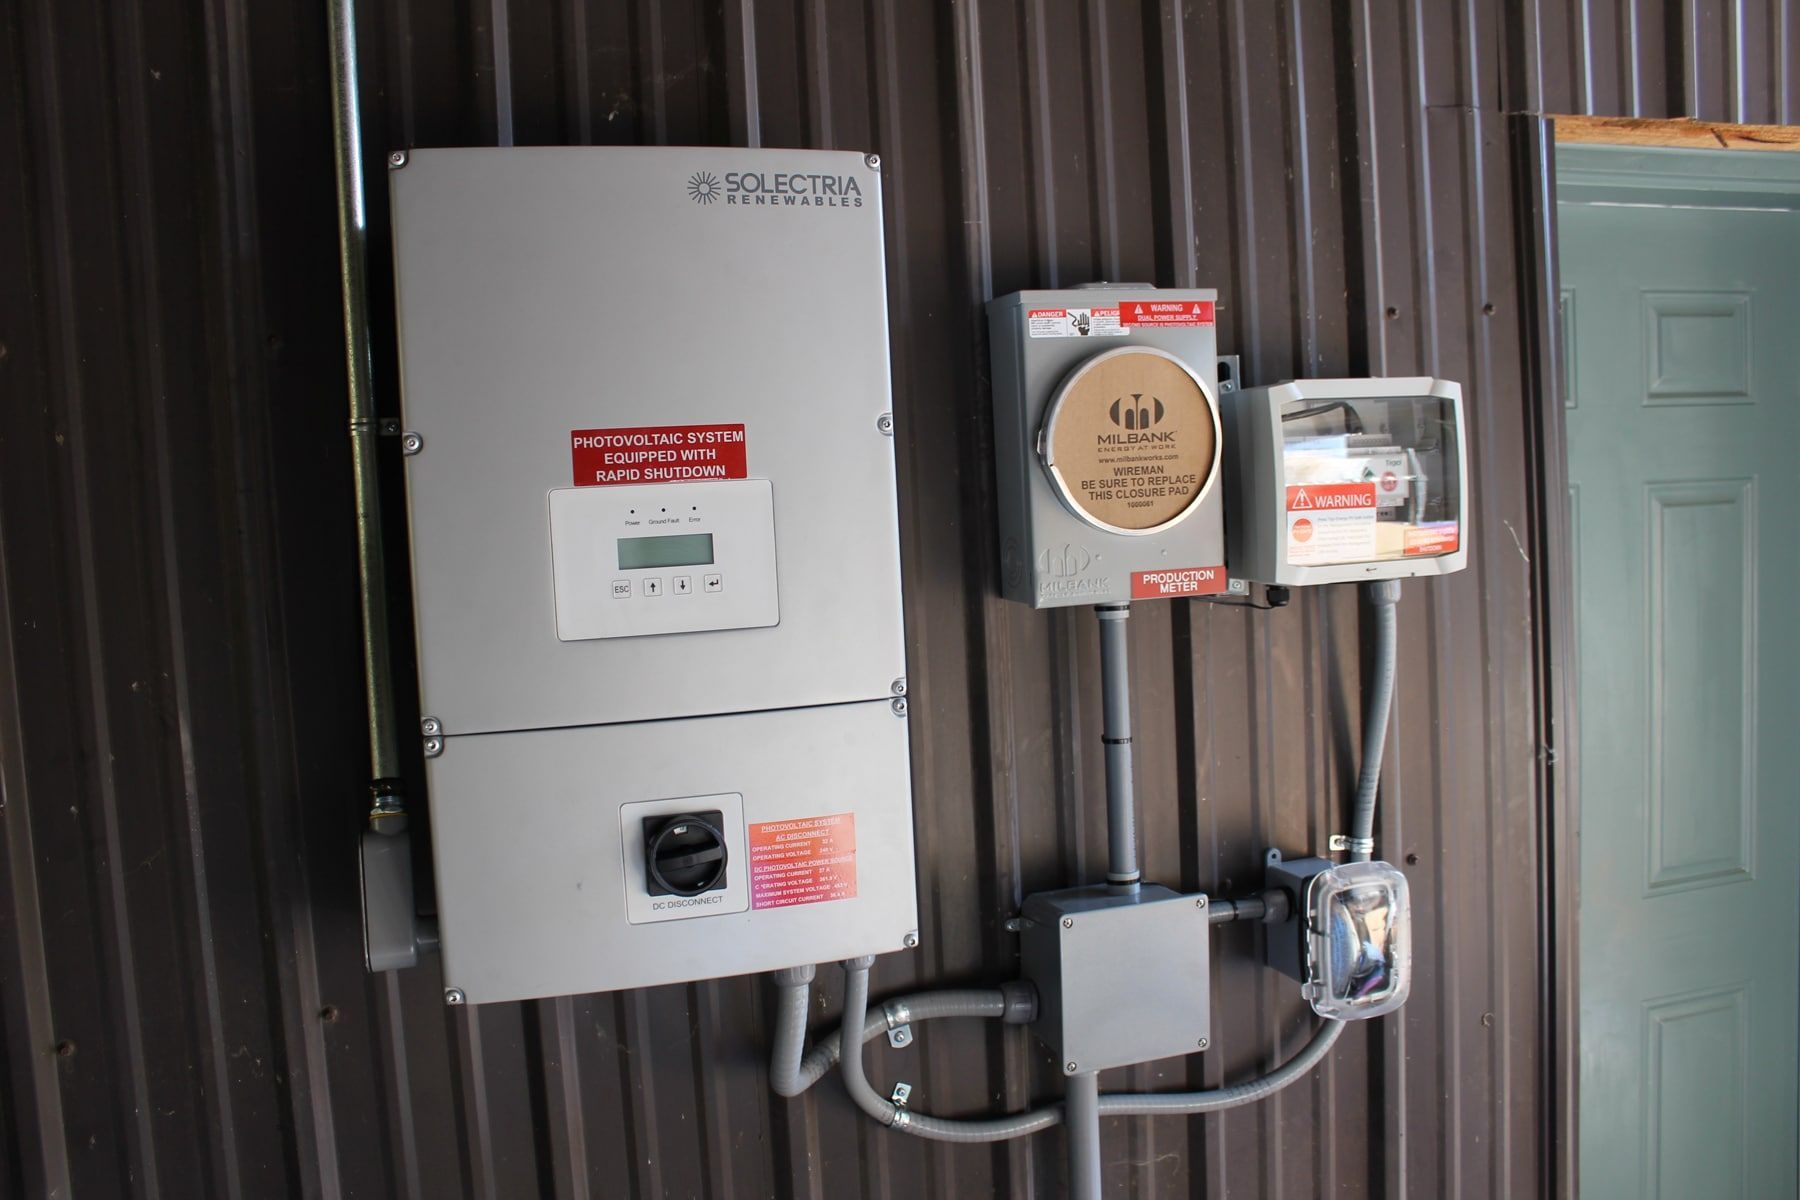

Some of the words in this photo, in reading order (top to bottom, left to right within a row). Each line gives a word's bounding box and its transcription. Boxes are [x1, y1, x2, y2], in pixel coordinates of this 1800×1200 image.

[725, 173, 862, 196] SOLECTRIA
[727, 195, 863, 207] RENEWABLES
[1150, 304, 1184, 312] WARNING
[573, 433, 684, 449] PHOTOVOLTAIC
[687, 430, 744, 444] SYSTEM
[1097, 431, 1176, 445] MILBANK
[604, 450, 677, 465] EQUIPPED
[680, 448, 716, 461] WITH
[1098, 454, 1179, 464] www.milbankworks.com
[596, 468, 640, 482] RAPID
[644, 465, 726, 480] SHUTDOWN
[1113, 465, 1164, 477] WIREMAN
[1081, 480, 1095, 490] BE
[1099, 478, 1128, 489] SURE
[1130, 477, 1144, 487] TO
[1149, 474, 1196, 486] REPLACE
[1089, 490, 1113, 501] THIS
[1115, 486, 1166, 499] CLOSURE
[1168, 486, 1189, 496] PAD
[1314, 493, 1372, 508] WARNING
[1143, 570, 1215, 584] PRODUCTION
[614, 585, 629, 594] ESC
[1160, 582, 1198, 594] METER
[761, 821, 814, 832] PHOTOVOLTAIC
[786, 829, 830, 840] DISCONNECT
[752, 844, 784, 852] OPERATING
[785, 841, 811, 849] CURRENT
[752, 852, 785, 861] OPERATING
[785, 850, 812, 858] VOLTAGE
[763, 862, 808, 872] PHOTOVOLTAIC
[754, 872, 786, 881] OPERATING
[786, 869, 813, 877] CURRENT
[787, 878, 813, 886] VOLTAGE
[756, 890, 783, 898] MAXIMUM
[783, 888, 805, 896] SYSTEM
[805, 885, 830, 893] VOLTAGE
[652, 902, 666, 911] DC
[667, 896, 723, 910] DISCONNECT
[756, 900, 775, 908] SHORT
[775, 897, 798, 906] CIRCUIT
[798, 894, 824, 903] CURRENT
